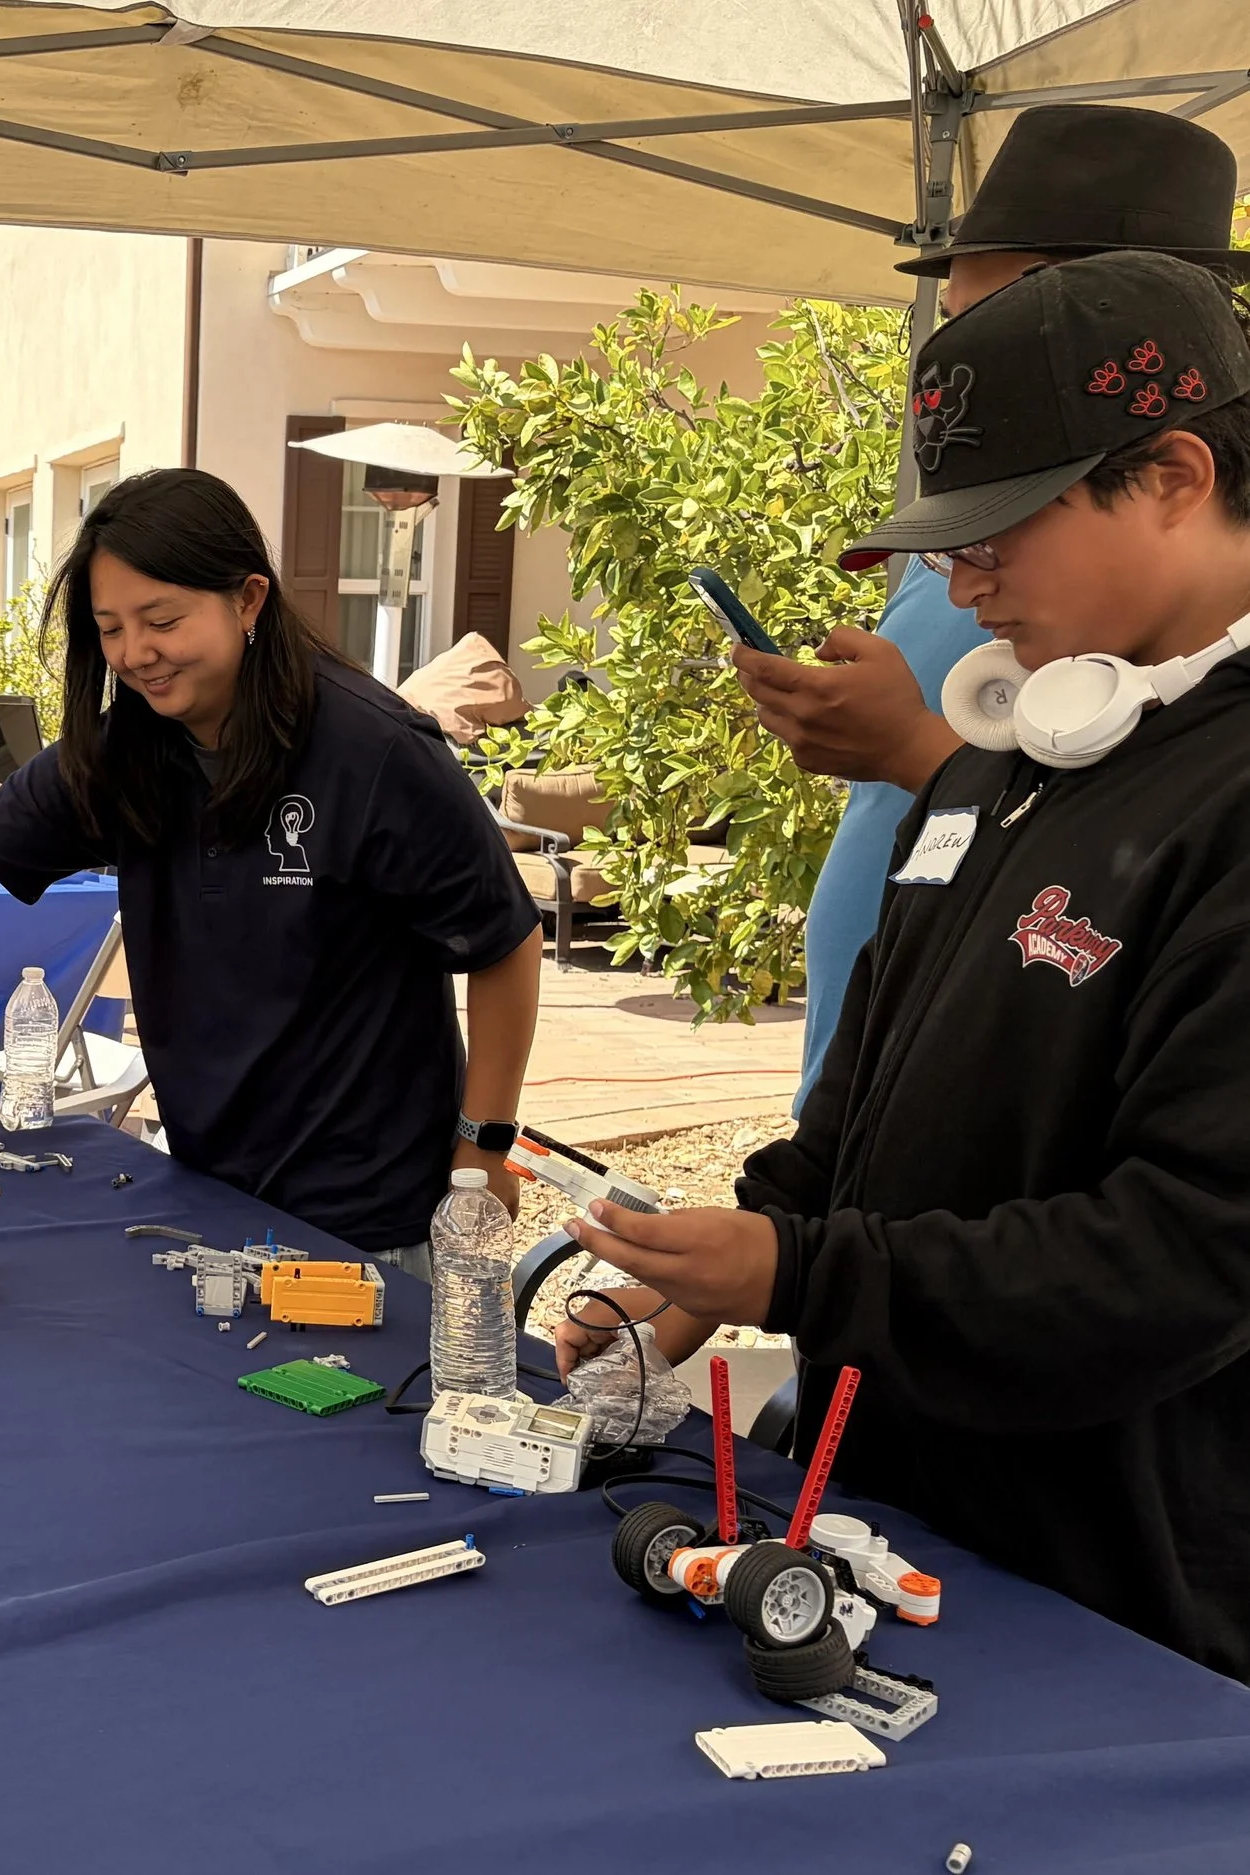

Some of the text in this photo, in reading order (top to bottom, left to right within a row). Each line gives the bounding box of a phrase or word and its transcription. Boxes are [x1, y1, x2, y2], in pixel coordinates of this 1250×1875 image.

[994, 688, 1008, 705] R
[263, 876, 314, 887] INSPIRATION
[1027, 932, 1068, 963] ACADEMY
